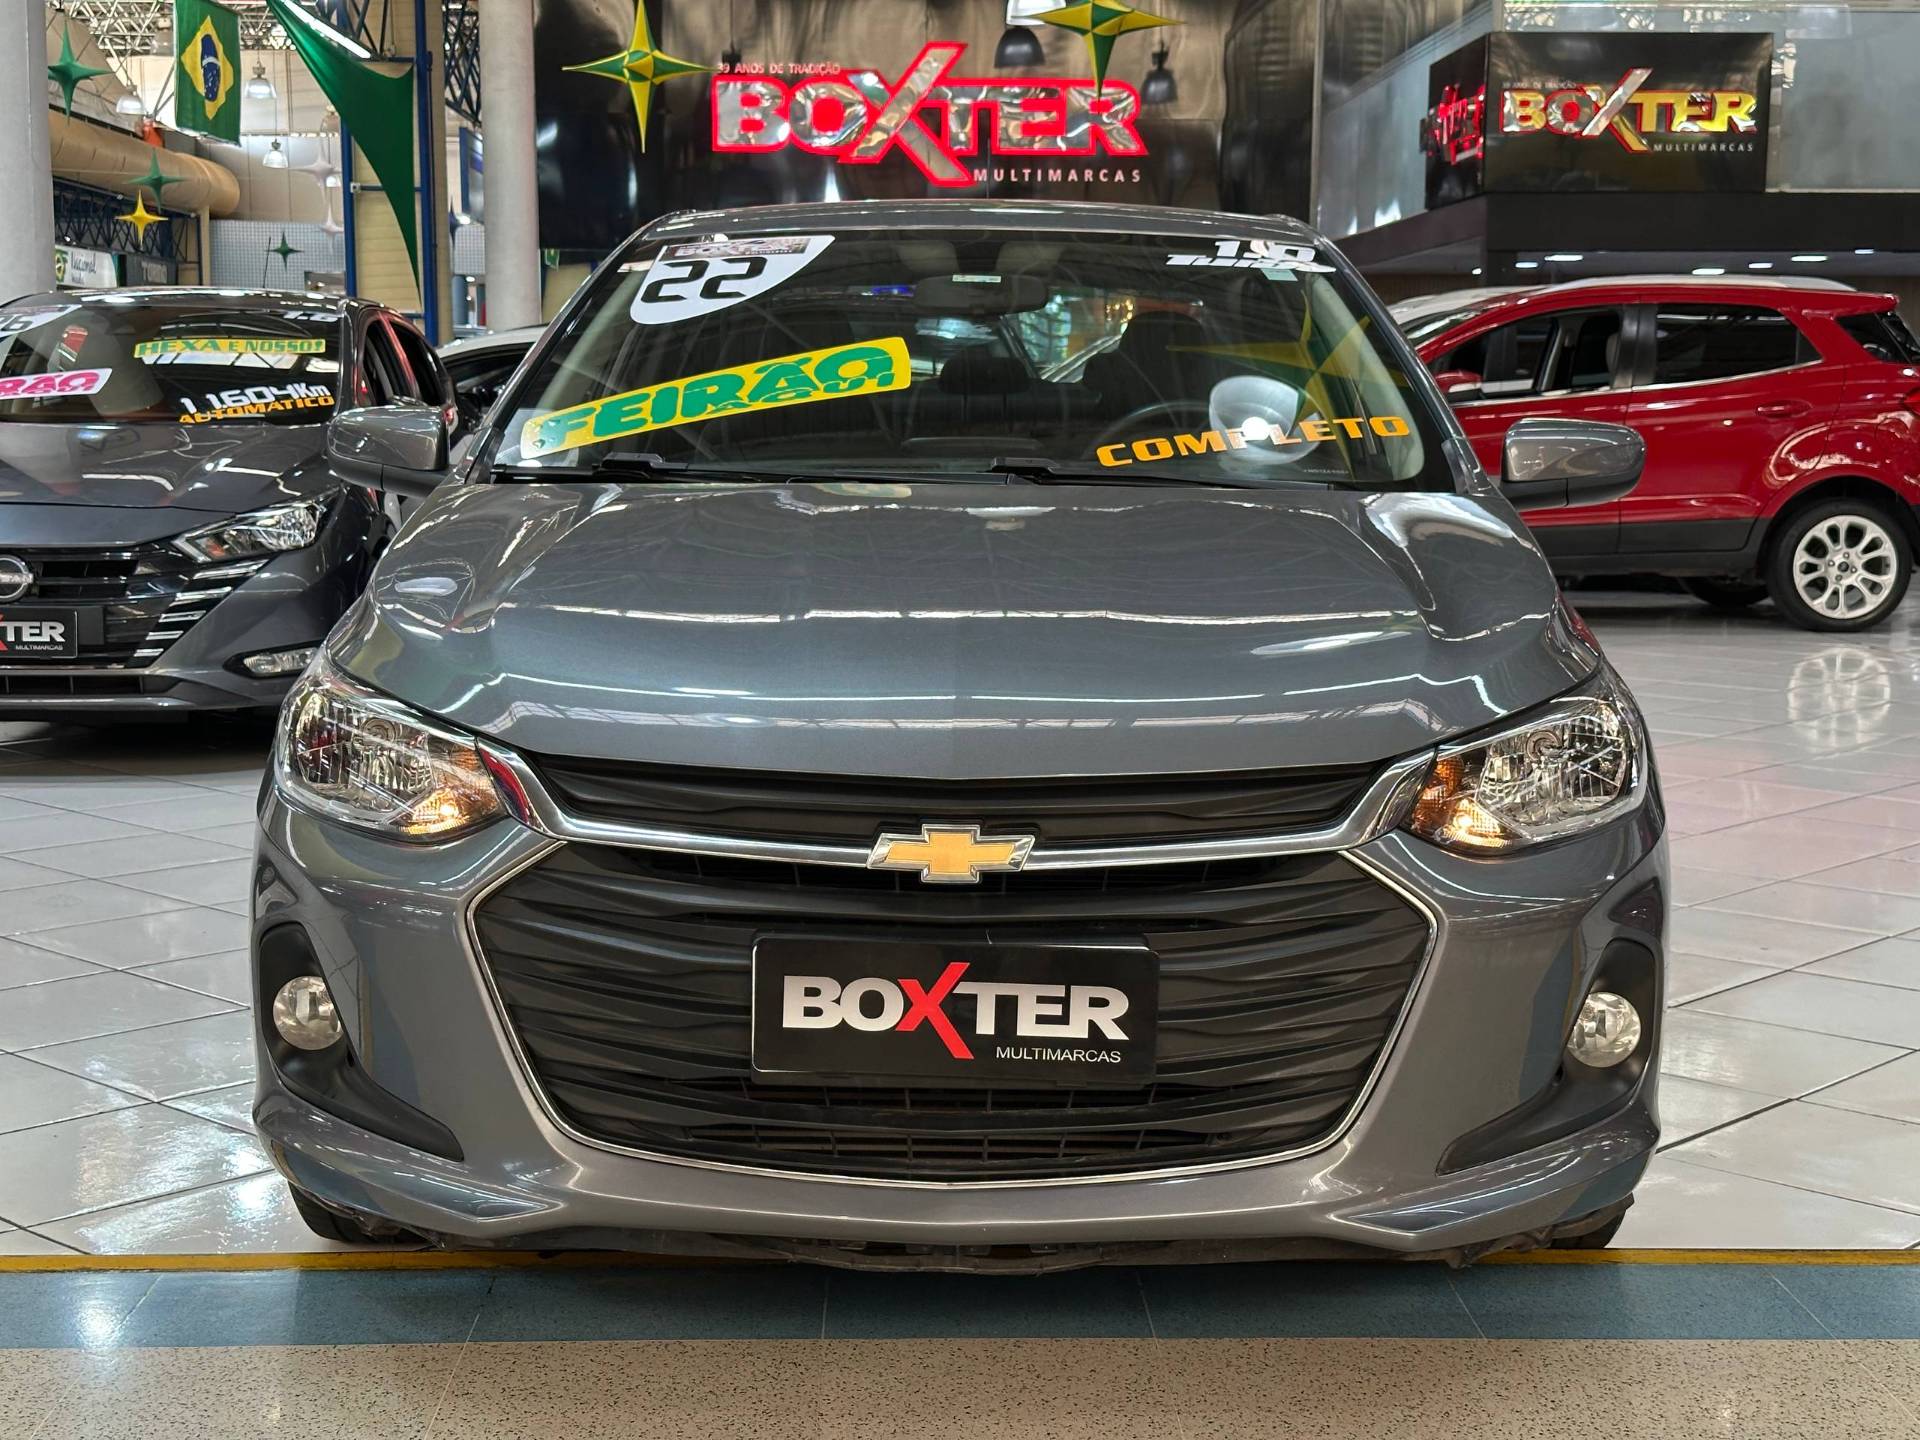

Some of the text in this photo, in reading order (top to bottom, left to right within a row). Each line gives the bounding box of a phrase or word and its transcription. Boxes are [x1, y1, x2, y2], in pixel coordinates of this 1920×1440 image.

[735, 62, 765, 74] ANOS
[769, 63, 784, 74] DE
[789, 61, 841, 77] TRADIÇÃO
[712, 41, 1148, 187] BOXTER
[1501, 67, 1757, 153] BOXTER
[1653, 143, 1754, 152] MULTIMARCAS
[974, 168, 1142, 183] MULTIMARCAS
[640, 256, 768, 304] 22
[139, 339, 219, 357] HEXA
[244, 339, 323, 352] NOSSO!
[538, 346, 895, 449] FEIRÃO
[1096, 416, 1410, 467] COMPLETO
[782, 962, 1130, 1060] BOXTER
[996, 1046, 1121, 1064] MULTIMARCAS
